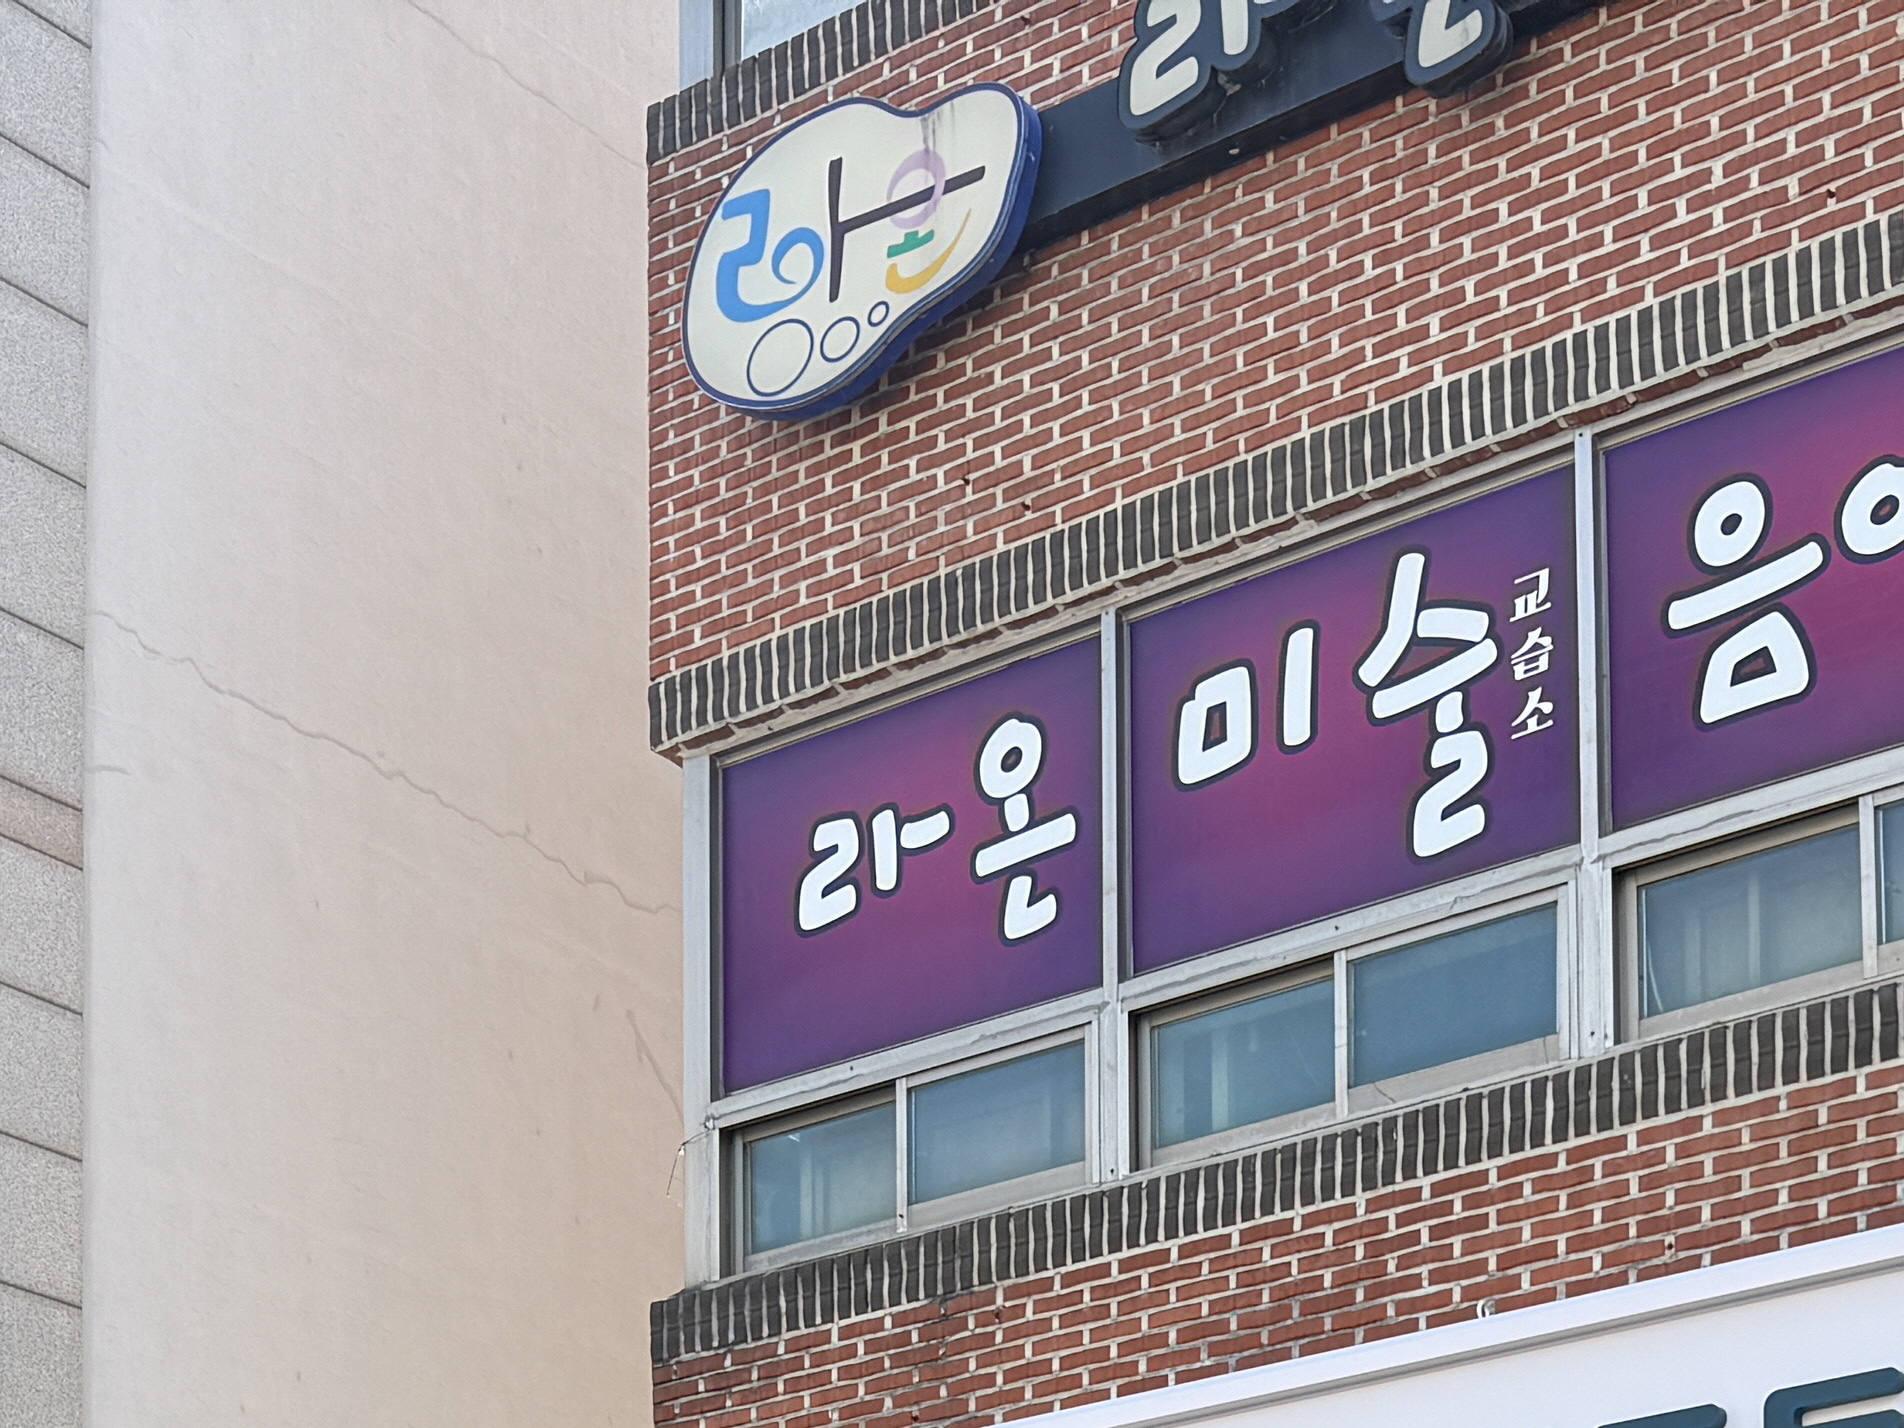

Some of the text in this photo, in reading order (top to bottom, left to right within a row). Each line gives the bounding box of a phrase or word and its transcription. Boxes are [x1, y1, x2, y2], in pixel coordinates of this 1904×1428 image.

[797, 718, 1076, 940] 라온
[1177, 552, 1498, 859] 미술
[1508, 567, 1555, 741] 교습소
